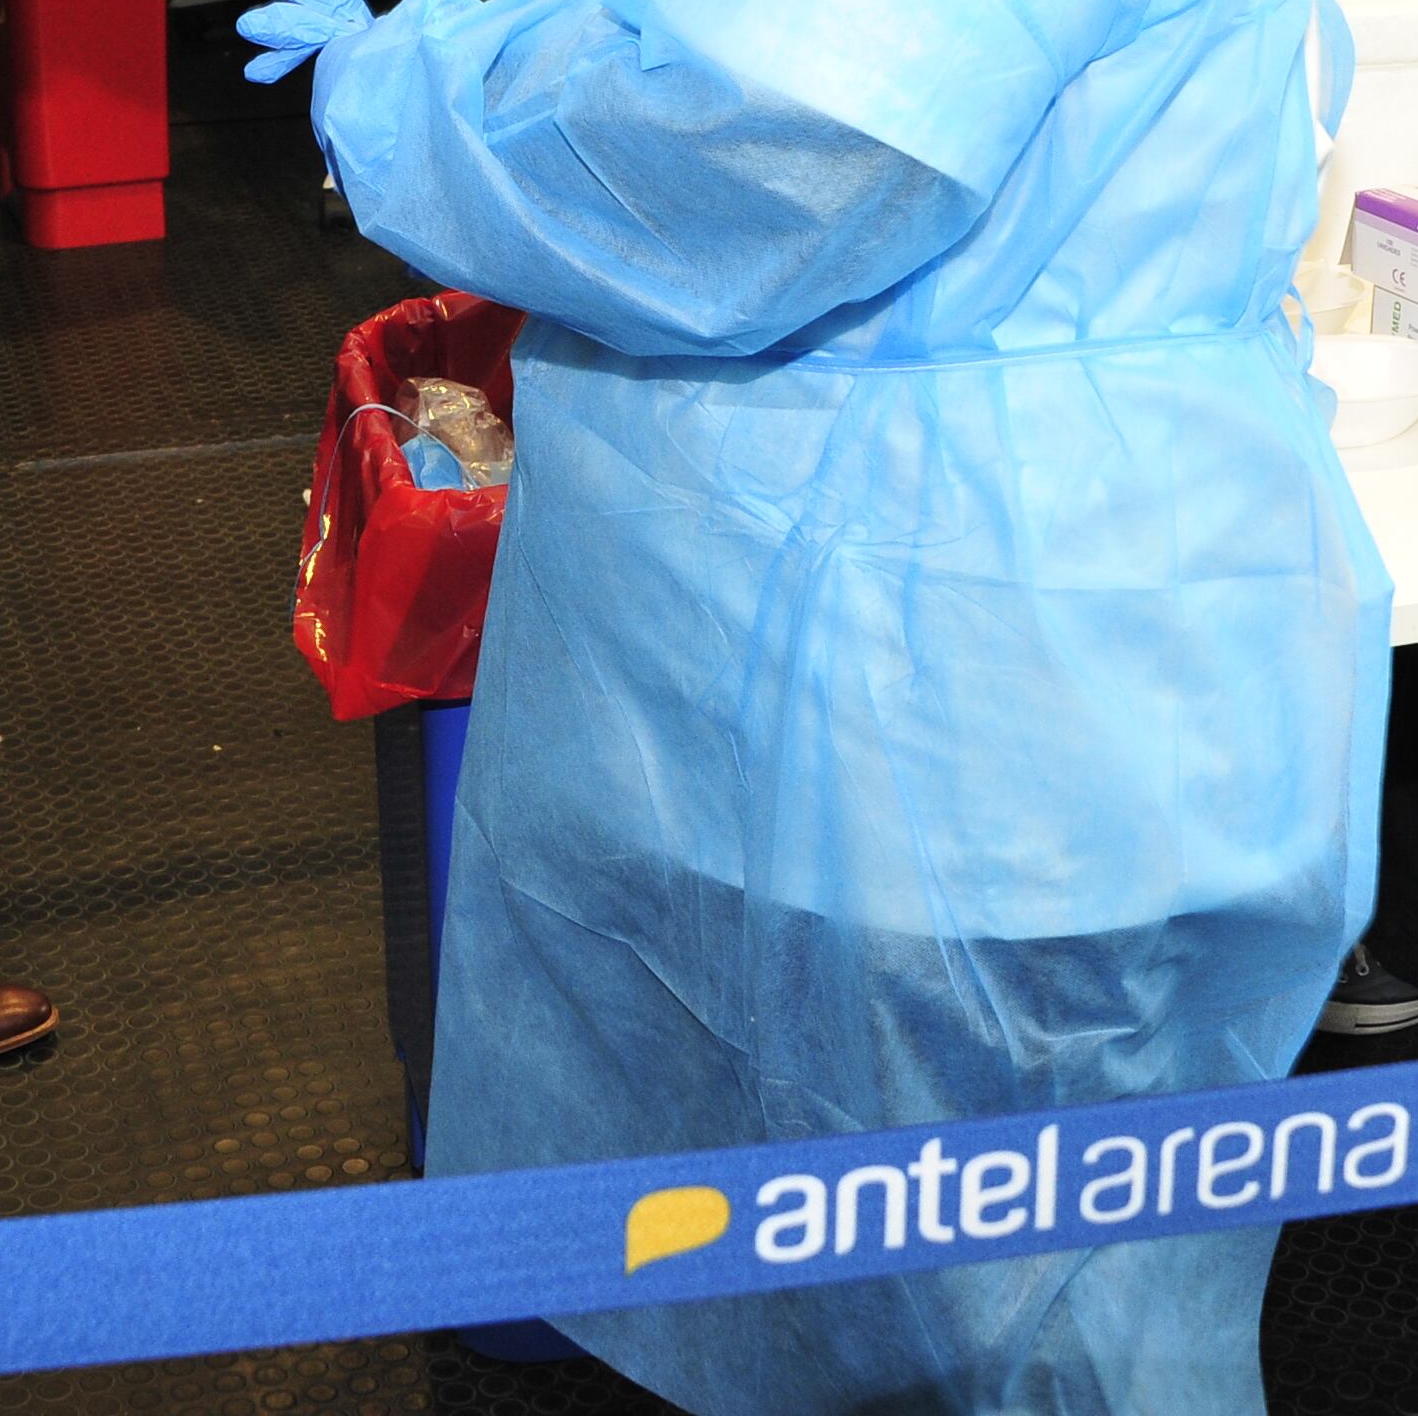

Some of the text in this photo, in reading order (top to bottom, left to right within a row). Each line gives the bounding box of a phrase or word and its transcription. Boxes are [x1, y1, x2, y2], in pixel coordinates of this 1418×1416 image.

[1392, 301, 1402, 334] MED
[753, 1101, 1411, 1264] antel arena
